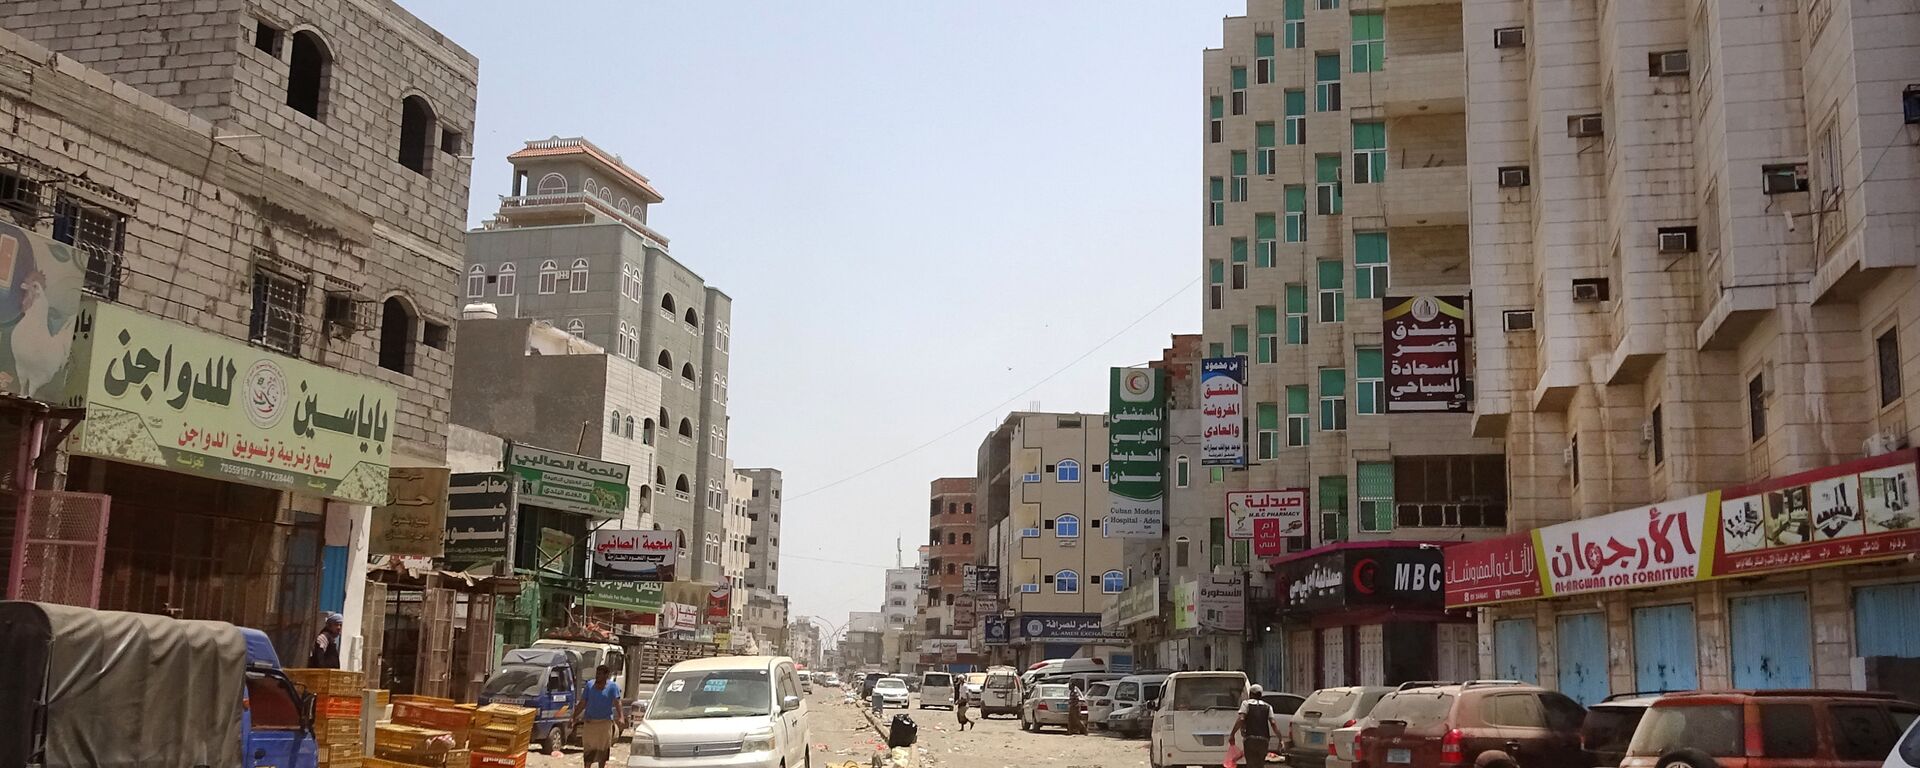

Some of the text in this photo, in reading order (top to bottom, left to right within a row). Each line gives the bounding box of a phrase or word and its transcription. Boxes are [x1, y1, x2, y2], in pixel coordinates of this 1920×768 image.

[1392, 320, 1456, 340] فندق
[1392, 337, 1457, 356] قصر
[104, 328, 236, 410] للدواجن
[1205, 362, 1228, 372] محمود
[1391, 360, 1458, 375] السعادة
[1204, 384, 1238, 399] للشقق
[1390, 377, 1460, 400] السياحي
[293, 380, 388, 455] باياسين
[1112, 406, 1162, 424] المستشفى
[1204, 402, 1240, 419] المفروشة
[178, 422, 229, 451] الدواجن
[1110, 428, 1162, 446] الكوبي
[1204, 424, 1240, 441] والعادي
[232, 434, 275, 463] وتسويق
[278, 441, 310, 470] وتربية
[1110, 448, 1162, 464] الحديث
[313, 452, 332, 474] لبيع
[577, 461, 623, 479] ملحمة
[448, 476, 508, 494] معاص
[1110, 470, 1160, 484] عدن
[1245, 494, 1300, 512] صيدلية
[1110, 517, 1138, 525] Hospital
[643, 535, 672, 550] ملحمة
[1552, 508, 1696, 578] الأرجوان
[1502, 543, 1534, 578] للأثاث
[1395, 563, 1441, 592] MBC
[1609, 574, 1630, 586] FOR
[1632, 566, 1694, 583] FORNITURE
[1046, 620, 1076, 630] للصرافة
